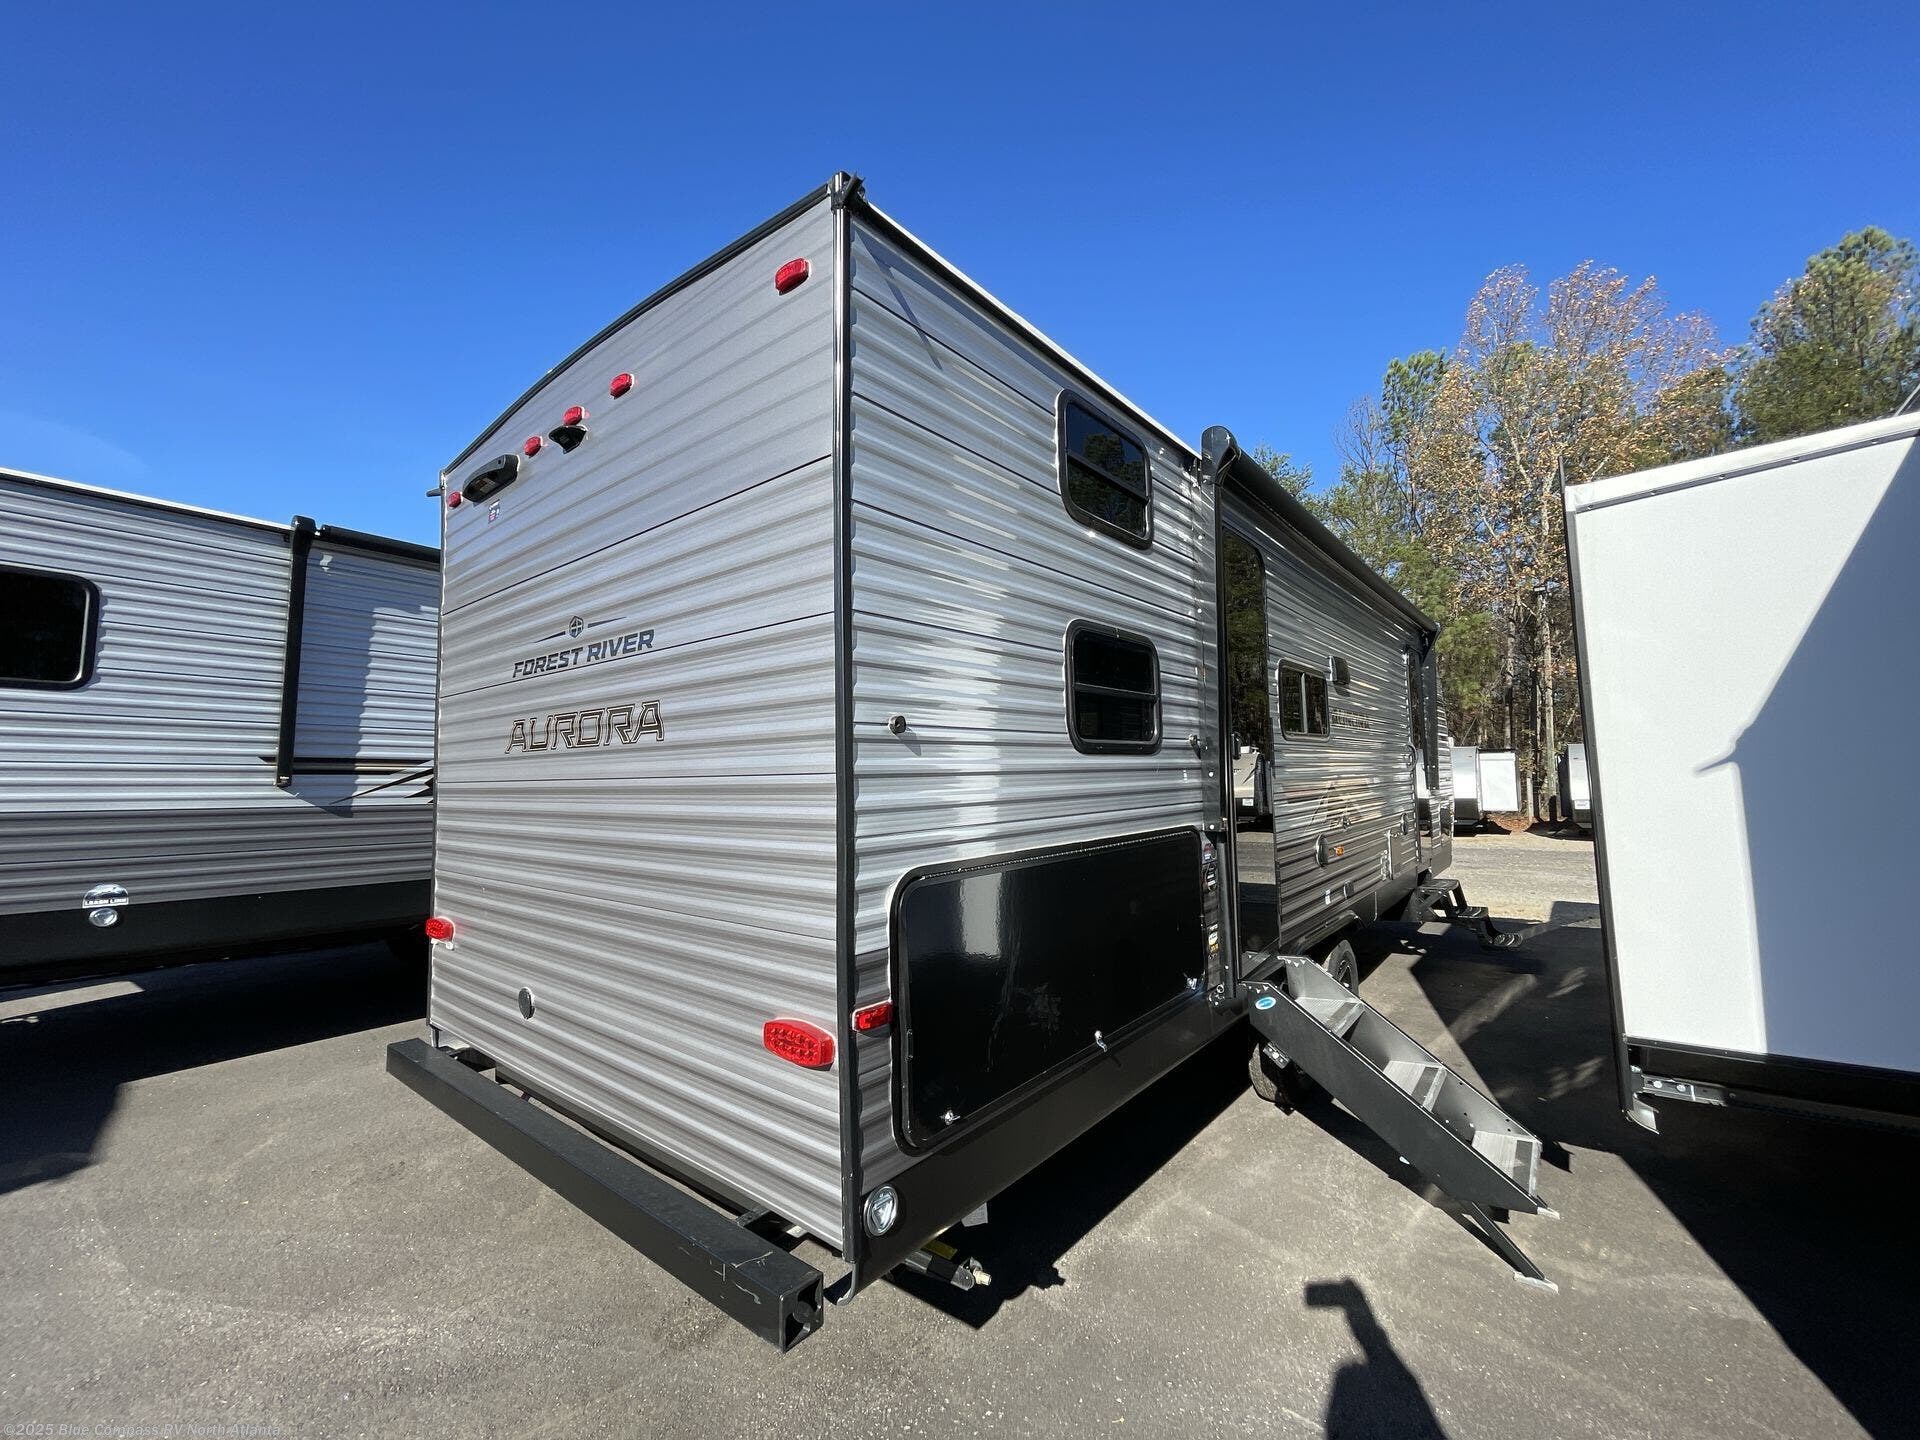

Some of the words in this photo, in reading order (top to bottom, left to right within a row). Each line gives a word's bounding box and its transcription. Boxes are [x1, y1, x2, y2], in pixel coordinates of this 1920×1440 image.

[512, 647, 584, 679] FOREST
[586, 629, 655, 662] RIVER
[504, 700, 665, 754] AURORA
